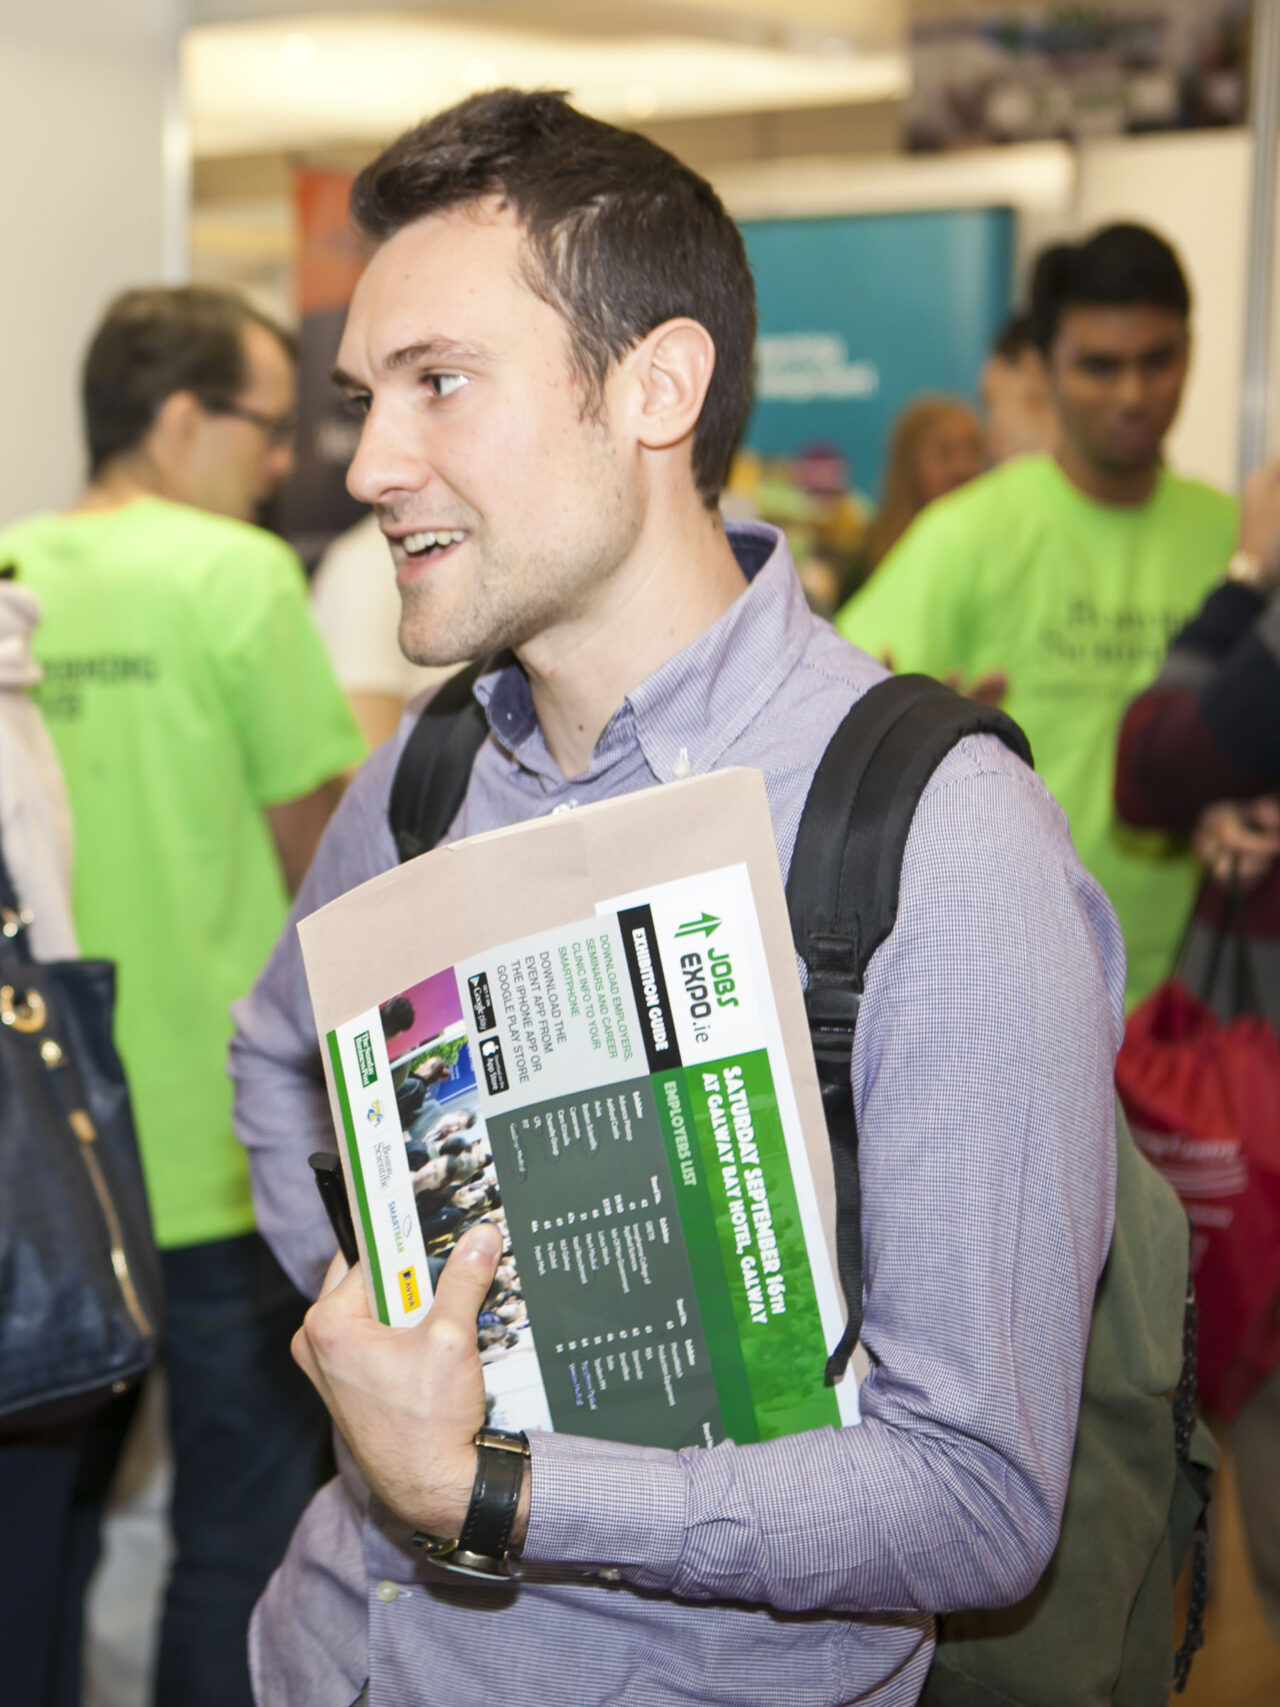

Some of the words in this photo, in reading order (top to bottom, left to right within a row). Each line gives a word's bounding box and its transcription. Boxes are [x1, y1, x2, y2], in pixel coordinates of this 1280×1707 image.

[510, 960, 523, 983] THE
[524, 955, 540, 992] EVENT
[571, 942, 586, 975] CLINIC
[585, 938, 603, 991] SEMINARS
[496, 964, 514, 1012] GOOGLE
[557, 946, 579, 1016] SMARTPHONE
[578, 977, 591, 1002] INFO
[631, 927, 659, 1006] EXHIBITION
[647, 1006, 669, 1051] GUIDE
[706, 945, 739, 1010] JOBS
[470, 986, 487, 1014] Google
[515, 984, 532, 1028] IPHONE
[533, 994, 545, 1017] APP
[539, 951, 561, 1018] DOWNLOAD
[553, 1020, 566, 1043] THE
[584, 1004, 595, 1018] TO
[596, 992, 608, 1015] AND
[599, 934, 619, 994] DOWNLOAD
[611, 996, 633, 1061] EMPLOYERS,
[679, 952, 716, 1043] EXPO.ie
[360, 1032, 369, 1044] The
[476, 1014, 488, 1030] play
[506, 1015, 520, 1042] PLAY
[538, 1019, 553, 1053] FROM
[587, 1020, 601, 1049] YOUR
[601, 1016, 617, 1058] CAREER
[524, 1030, 537, 1052] APP
[361, 1043, 375, 1075] Sunday
[485, 1057, 495, 1071] App
[512, 1044, 529, 1083] STORE
[529, 1054, 542, 1072] OR
[489, 1071, 499, 1090] Store
[701, 1071, 720, 1093] AT
[581, 1103, 592, 1124] Boston
[705, 1093, 735, 1165] GALWAY
[585, 1123, 598, 1151] Scientific
[663, 1080, 691, 1159] EMPLOYERS
[679, 1159, 697, 1186] LIST
[372, 1142, 390, 1190] Scientific
[380, 1144, 396, 1175] Boston
[720, 1165, 742, 1200] BAY
[722, 1065, 759, 1167] SATURDAY
[742, 1167, 781, 1274] SEPTEMBER
[764, 1274, 789, 1314] 16TH
[387, 1200, 405, 1253] SMARTBEAR
[726, 1199, 753, 1255] HOTEL,
[627, 1246, 638, 1271] Sciences
[637, 1256, 650, 1278] College
[403, 1281, 415, 1308] AVIVA
[643, 1277, 652, 1285] of
[739, 1254, 768, 1325] GALWAY
[662, 1374, 676, 1406] Equipment
